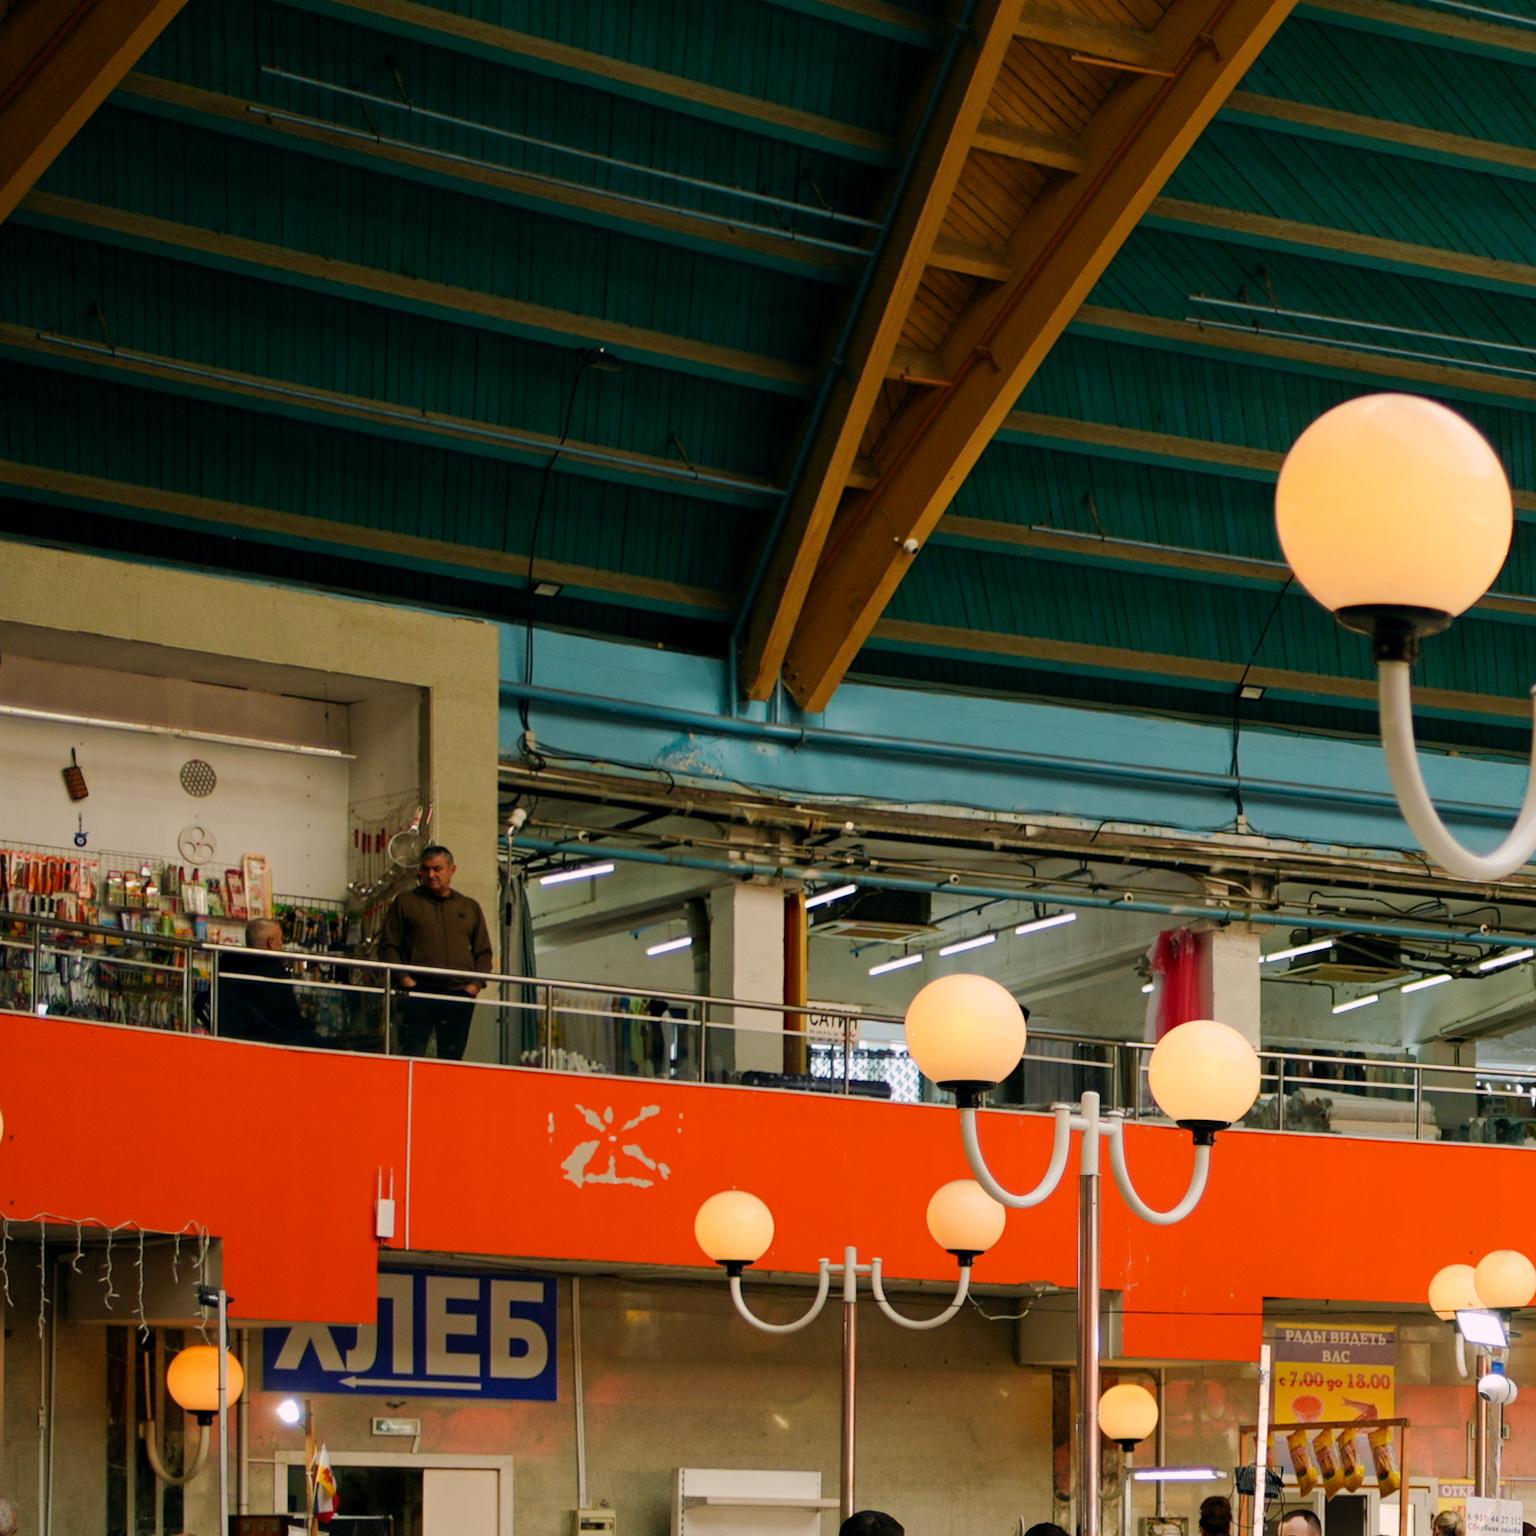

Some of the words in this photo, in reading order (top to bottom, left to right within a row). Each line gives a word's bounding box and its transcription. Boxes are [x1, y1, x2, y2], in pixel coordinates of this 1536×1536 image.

[1285, 1329, 1327, 1345] РАДЫ
[1330, 1331, 1387, 1346] ВИДЕТЬ
[1322, 1350, 1350, 1363] ВАС
[1289, 1371, 1324, 1388] 7.00
[1347, 1373, 1391, 1389] 18.00
[1442, 1485, 1475, 1497] ОТКР
